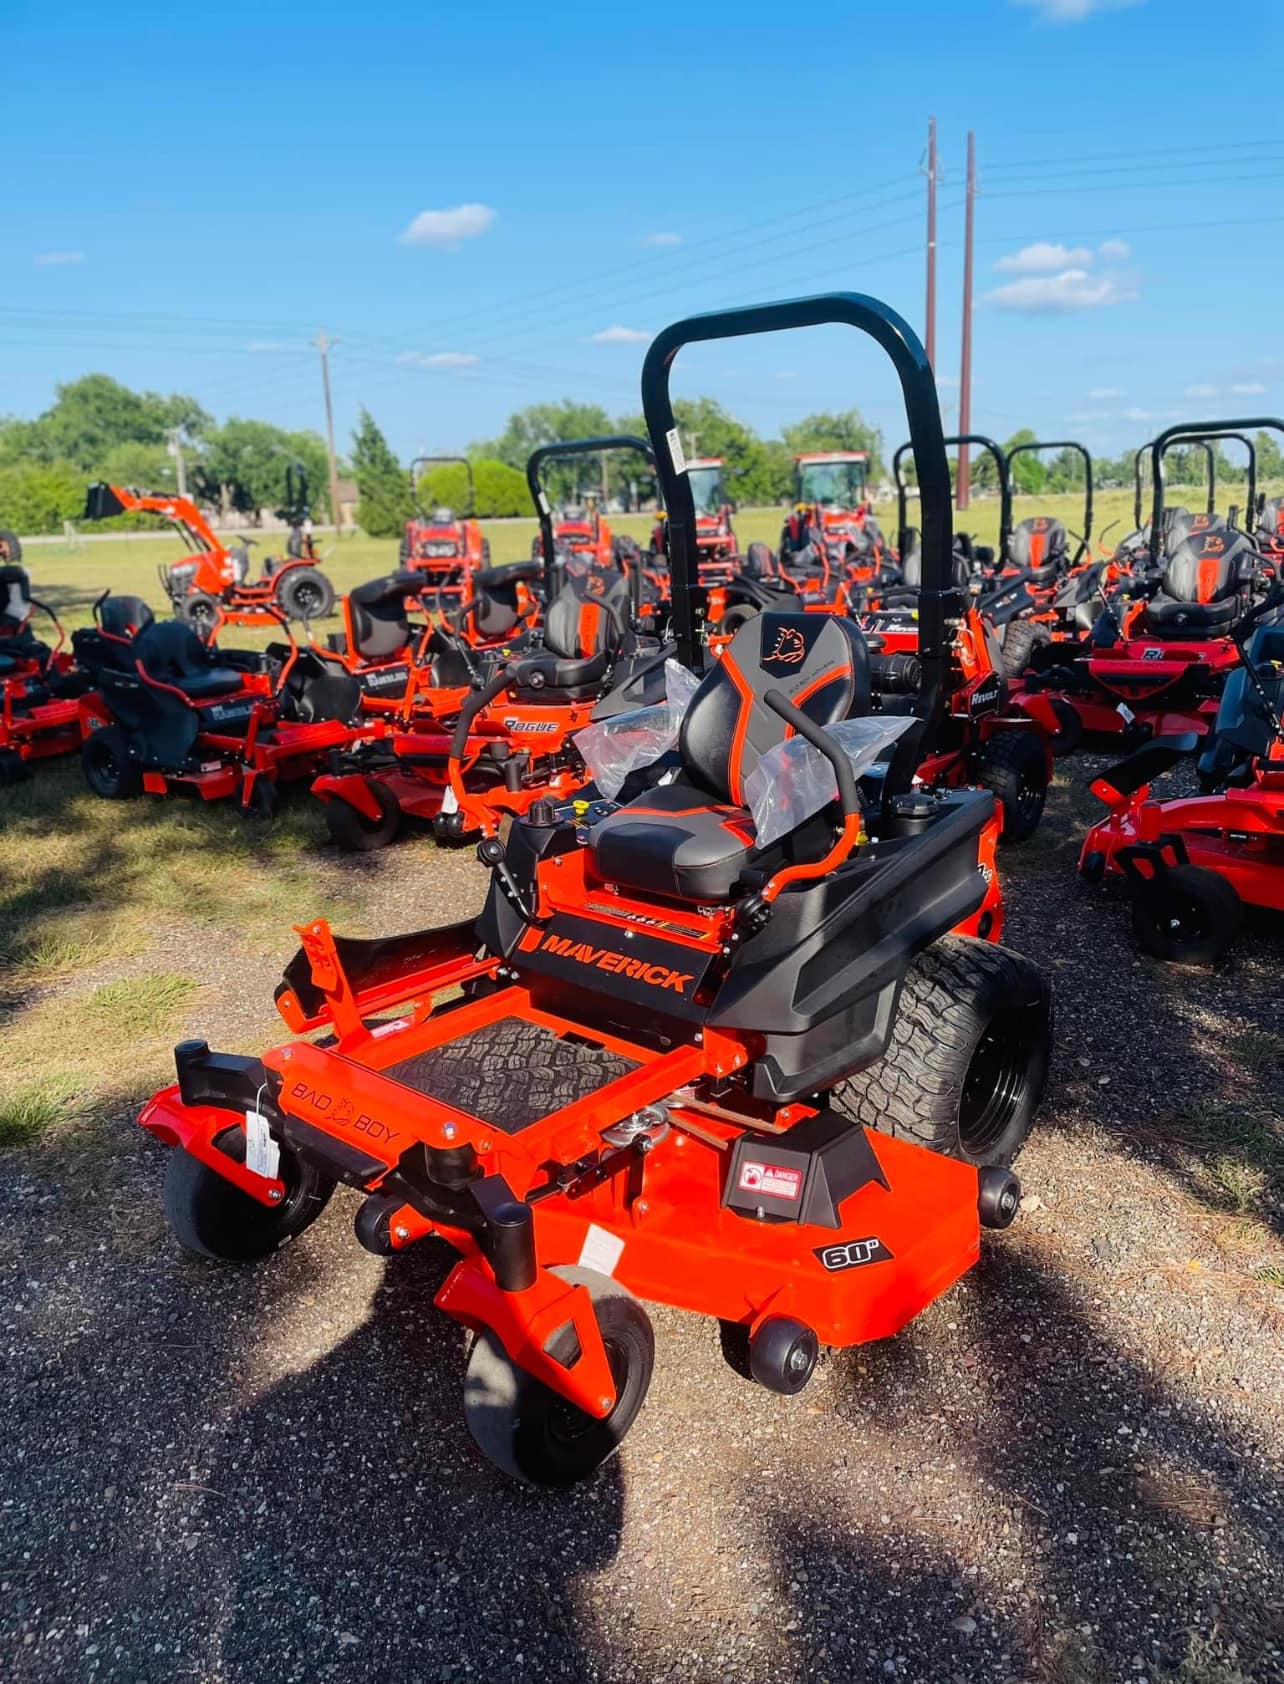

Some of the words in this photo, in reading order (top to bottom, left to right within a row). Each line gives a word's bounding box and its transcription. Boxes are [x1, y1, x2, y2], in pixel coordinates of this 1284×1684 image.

[504, 716, 560, 733] ROGUE
[541, 935, 695, 993] MAVERICK
[291, 1082, 332, 1111] BAD
[354, 1114, 400, 1144] BOY
